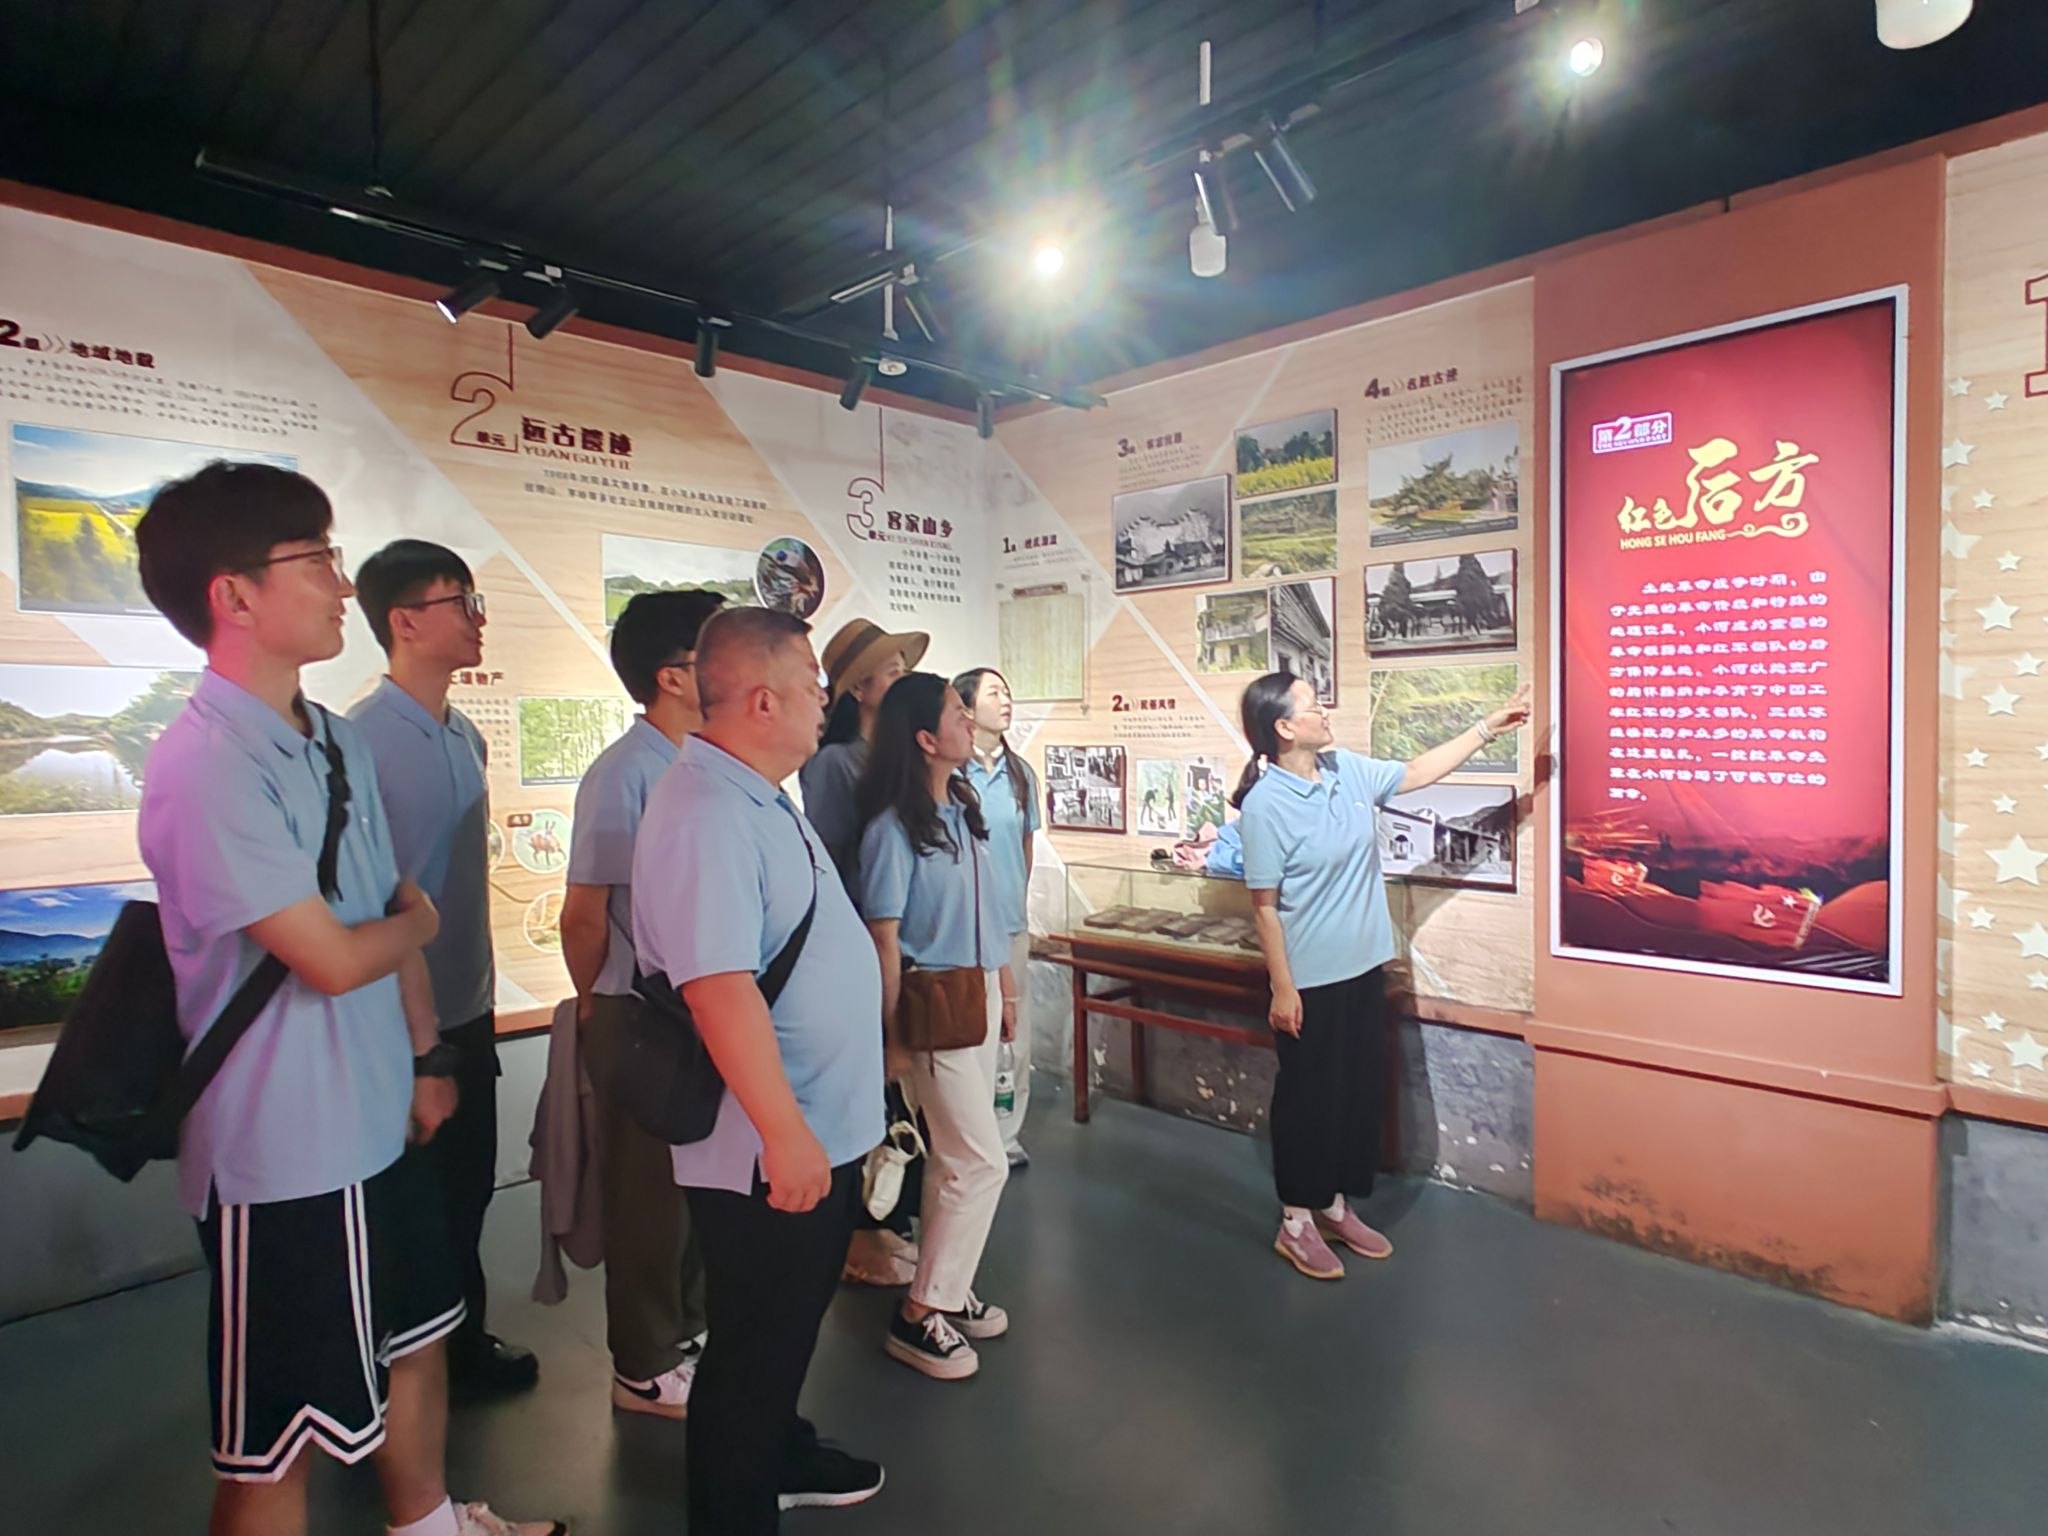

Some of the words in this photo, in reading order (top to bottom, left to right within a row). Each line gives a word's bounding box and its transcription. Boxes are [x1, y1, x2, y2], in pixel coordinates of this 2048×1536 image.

[887, 510, 953, 538] 客家山乡
[1620, 536, 1652, 550] HONG
[1654, 534, 1667, 546] SE
[1668, 531, 1693, 545] HOU
[1695, 529, 1726, 542] FANG
